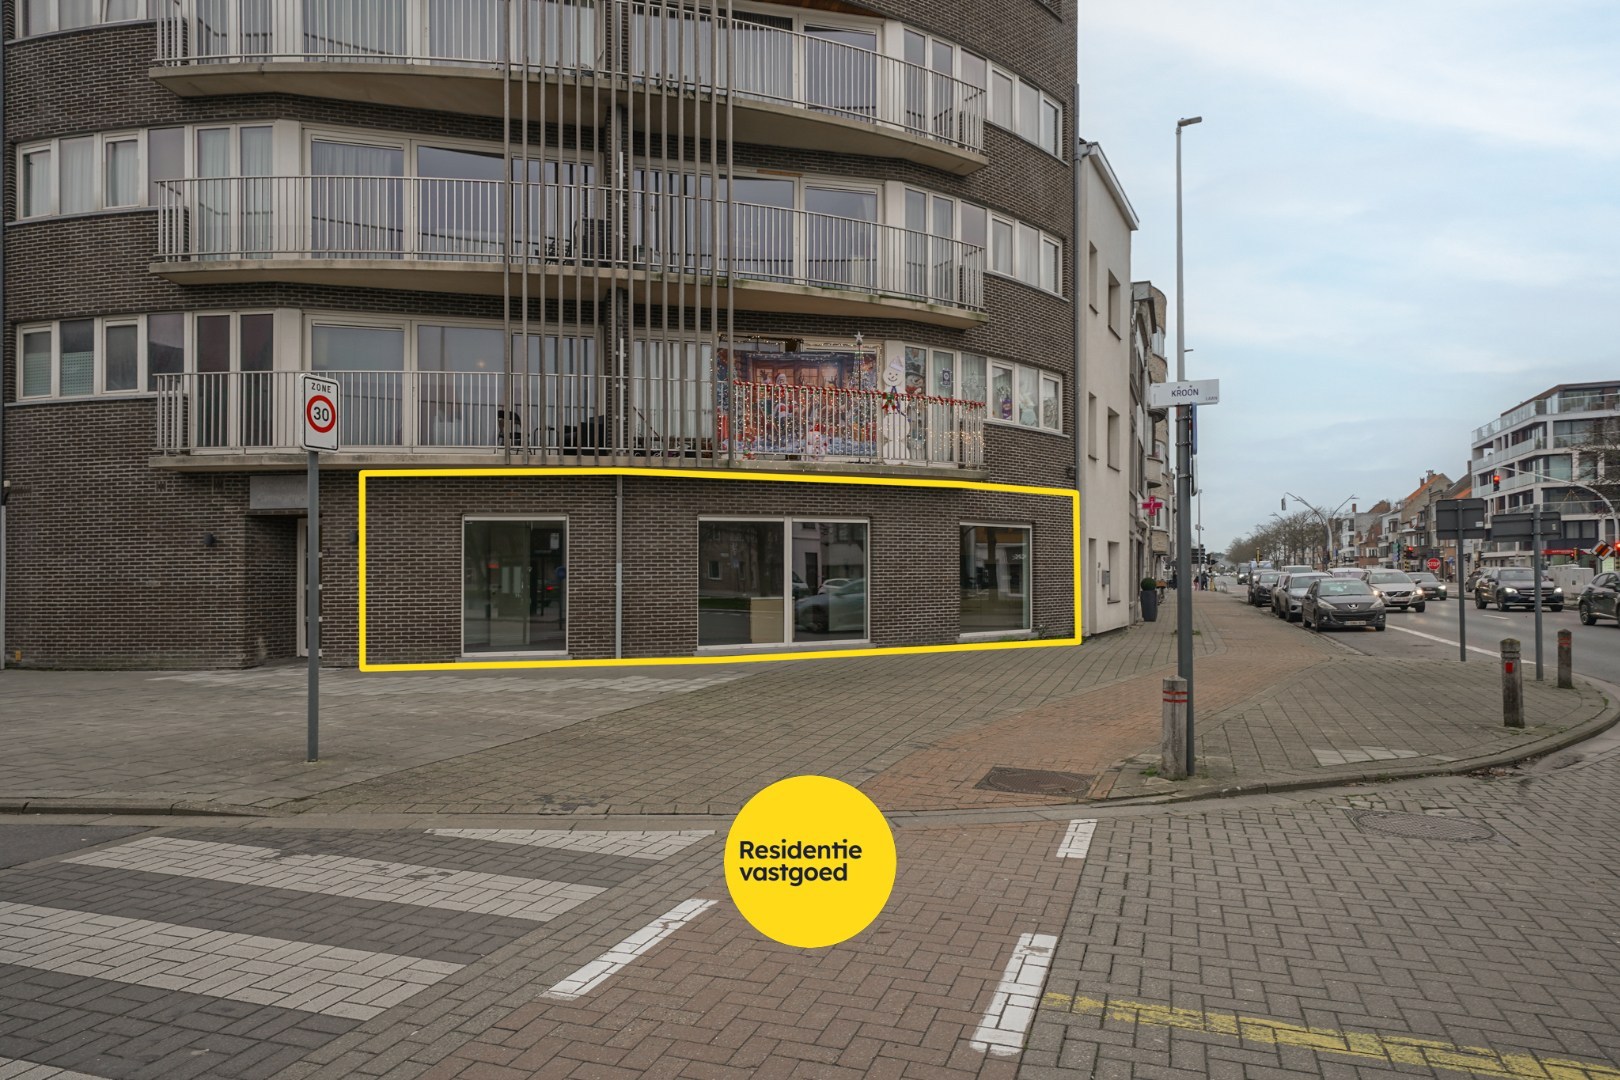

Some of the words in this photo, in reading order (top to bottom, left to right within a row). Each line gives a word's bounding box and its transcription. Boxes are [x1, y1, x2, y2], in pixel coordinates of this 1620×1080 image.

[311, 382, 332, 393] ZONE
[1171, 388, 1199, 397] KROON
[313, 407, 329, 421] 30
